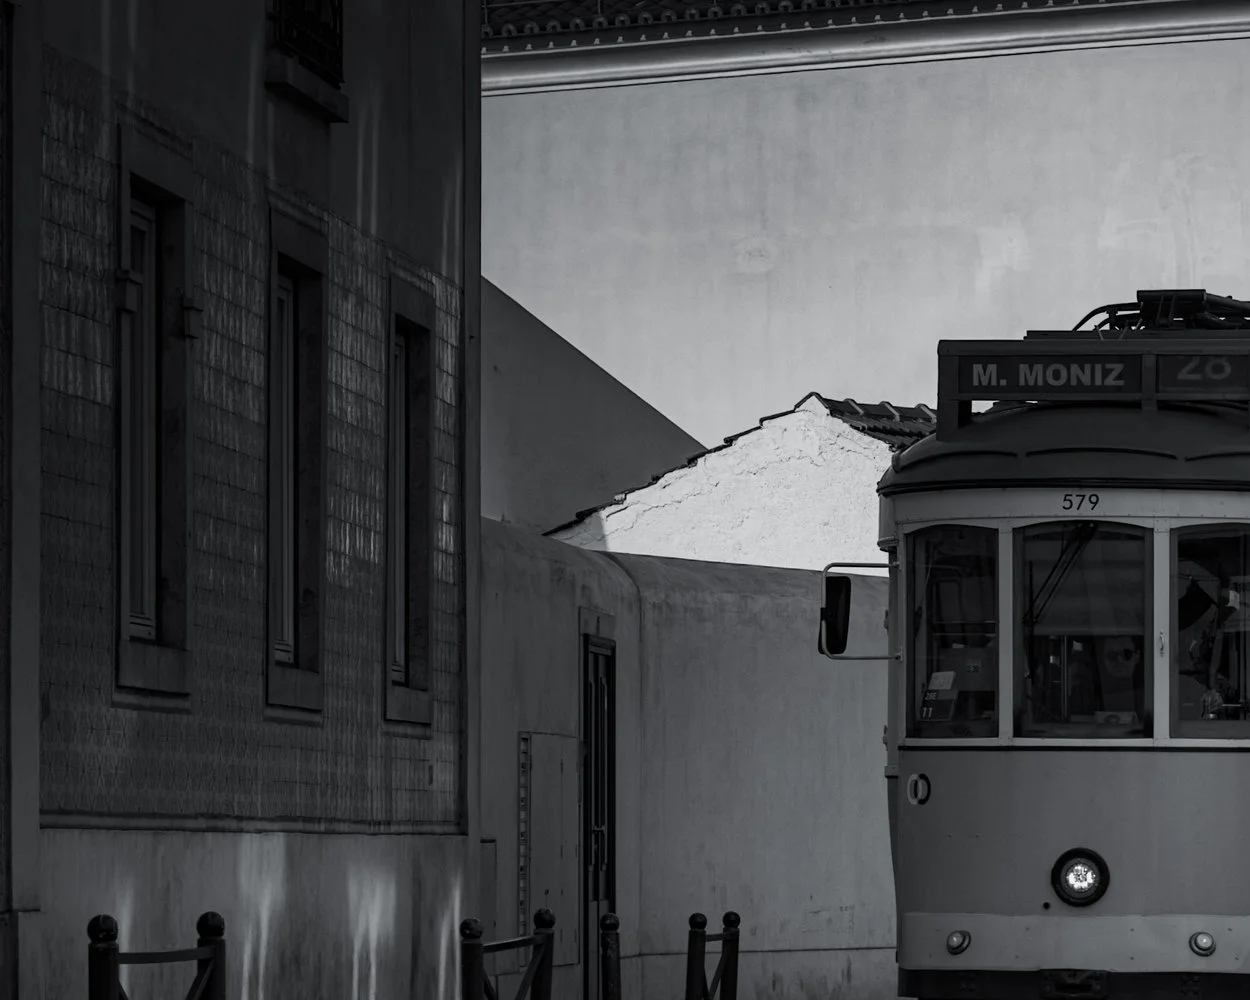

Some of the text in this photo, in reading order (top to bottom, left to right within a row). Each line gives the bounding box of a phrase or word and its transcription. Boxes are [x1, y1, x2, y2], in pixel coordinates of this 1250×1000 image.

[972, 363, 1125, 387] M. MONIZ
[1176, 355, 1232, 380] 28
[1062, 493, 1100, 511] 579
